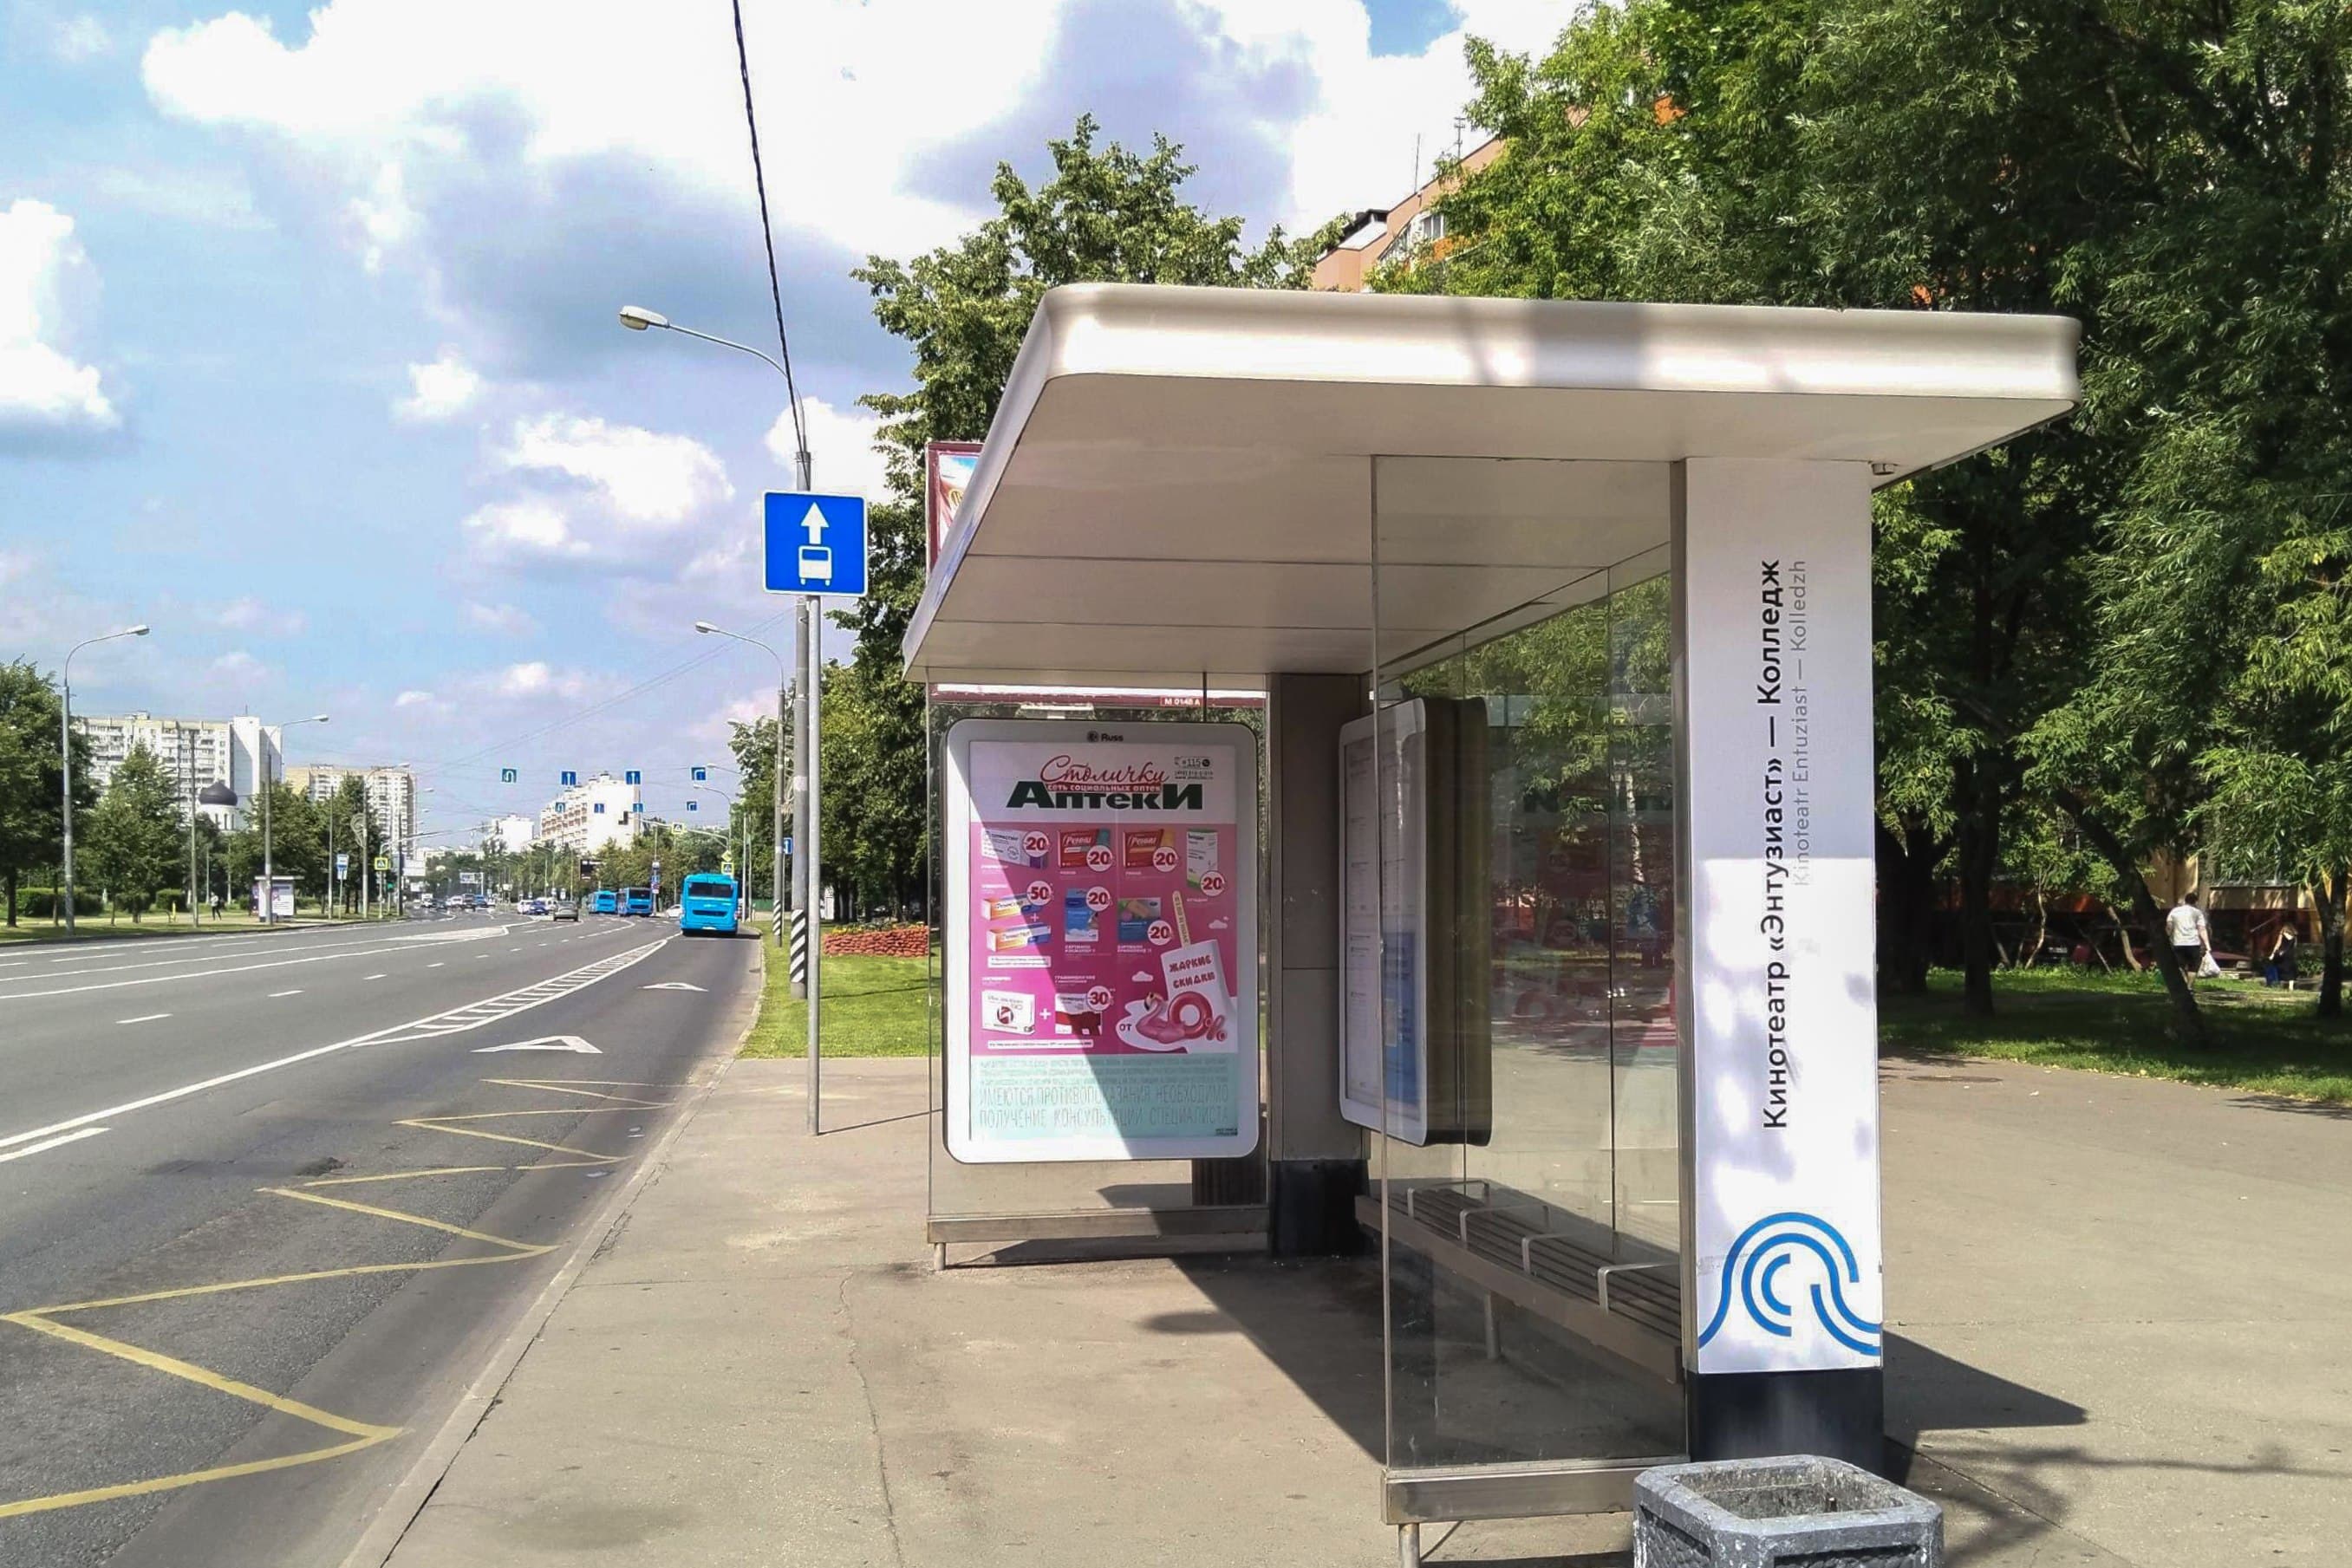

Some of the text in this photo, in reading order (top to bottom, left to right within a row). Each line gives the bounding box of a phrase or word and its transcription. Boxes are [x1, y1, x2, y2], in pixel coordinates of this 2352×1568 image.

[1757, 559, 1783, 704] Колледж
[1788, 561, 1807, 651] Kolledzh
[1040, 754, 1170, 784] Столички
[1100, 732, 1124, 742] Russ
[1791, 686, 1809, 782] Entuziast
[1761, 758, 1788, 952] «Энтузиаст»
[1793, 788, 1810, 886] Kinoteatr
[1169, 954, 1212, 973] ЖАРКИЕ
[1173, 972, 1215, 989] СКИДКИ
[1762, 961, 1790, 1129] Кинотеатр
